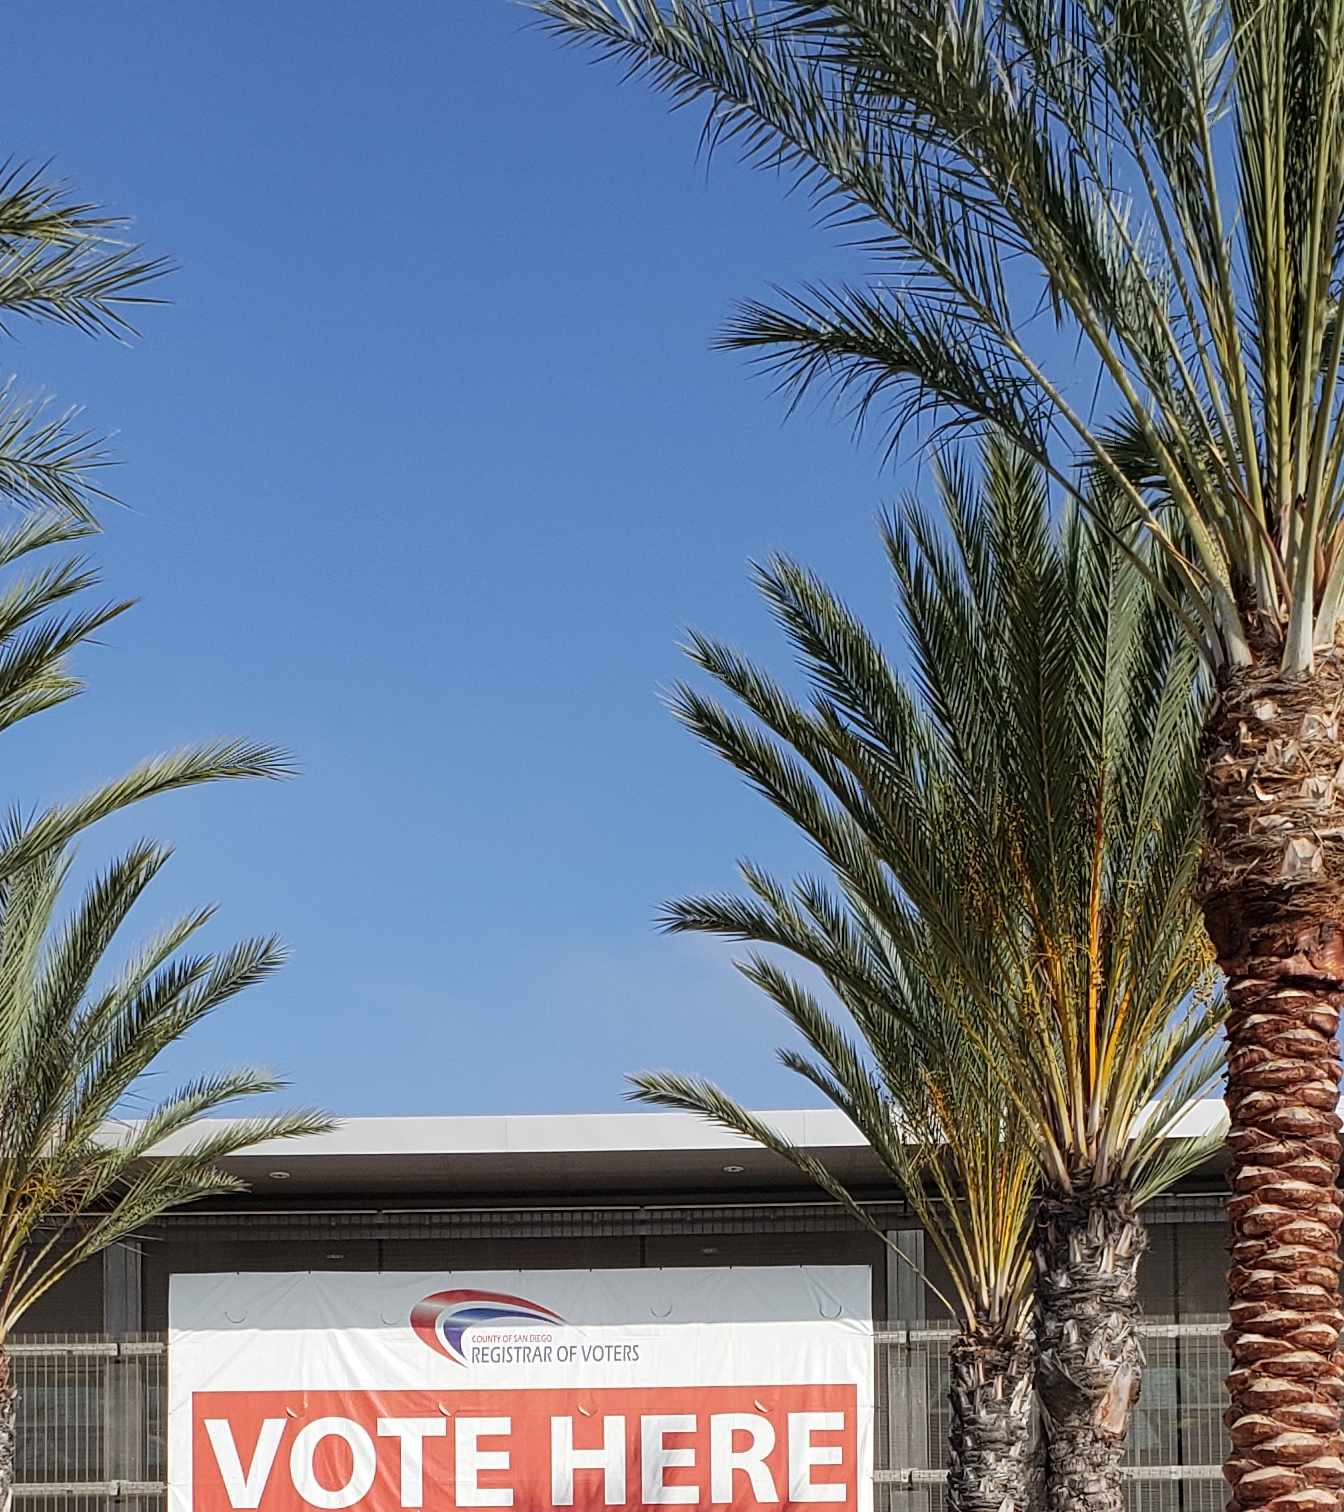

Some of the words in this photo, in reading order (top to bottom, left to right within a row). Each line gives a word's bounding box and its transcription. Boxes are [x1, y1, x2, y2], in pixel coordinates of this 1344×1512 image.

[472, 1335, 501, 1343] COUNTY
[503, 1335, 512, 1343] OF
[514, 1334, 528, 1343] SAN
[529, 1334, 552, 1343] DIEGO
[472, 1346, 552, 1363] REGISTRAR
[557, 1345, 577, 1363] OF
[582, 1344, 640, 1362] VOTERS
[203, 1416, 514, 1510] VOTE
[550, 1411, 847, 1507] HERE
